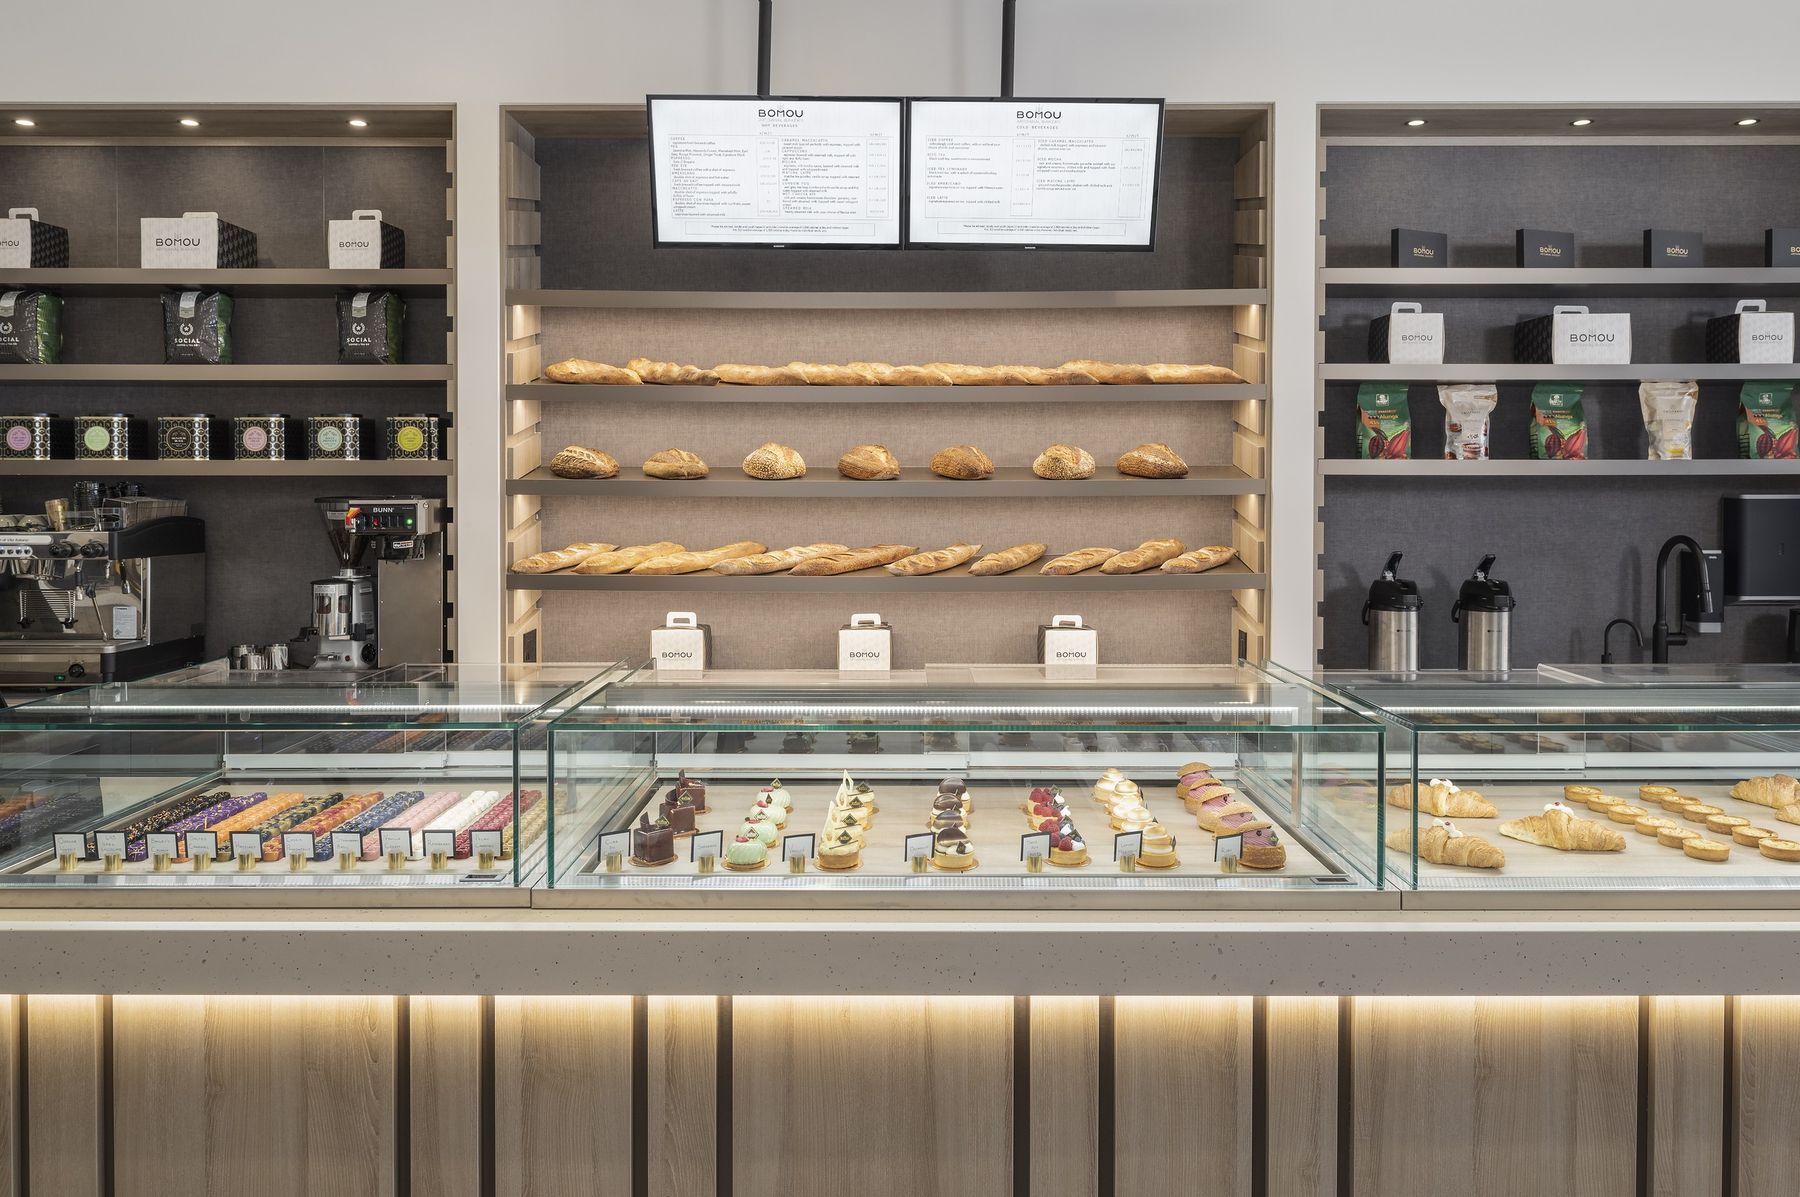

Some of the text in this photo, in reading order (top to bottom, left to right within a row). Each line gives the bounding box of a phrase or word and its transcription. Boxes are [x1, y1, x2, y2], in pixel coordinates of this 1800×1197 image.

[758, 109, 803, 118] BOMOU
[1016, 111, 1062, 119] BOMOU
[156, 238, 200, 246] BOMOU
[1413, 247, 1434, 255] BOMOU
[1666, 247, 1688, 255] BOMOU
[1570, 333, 1614, 342] BOMOU
